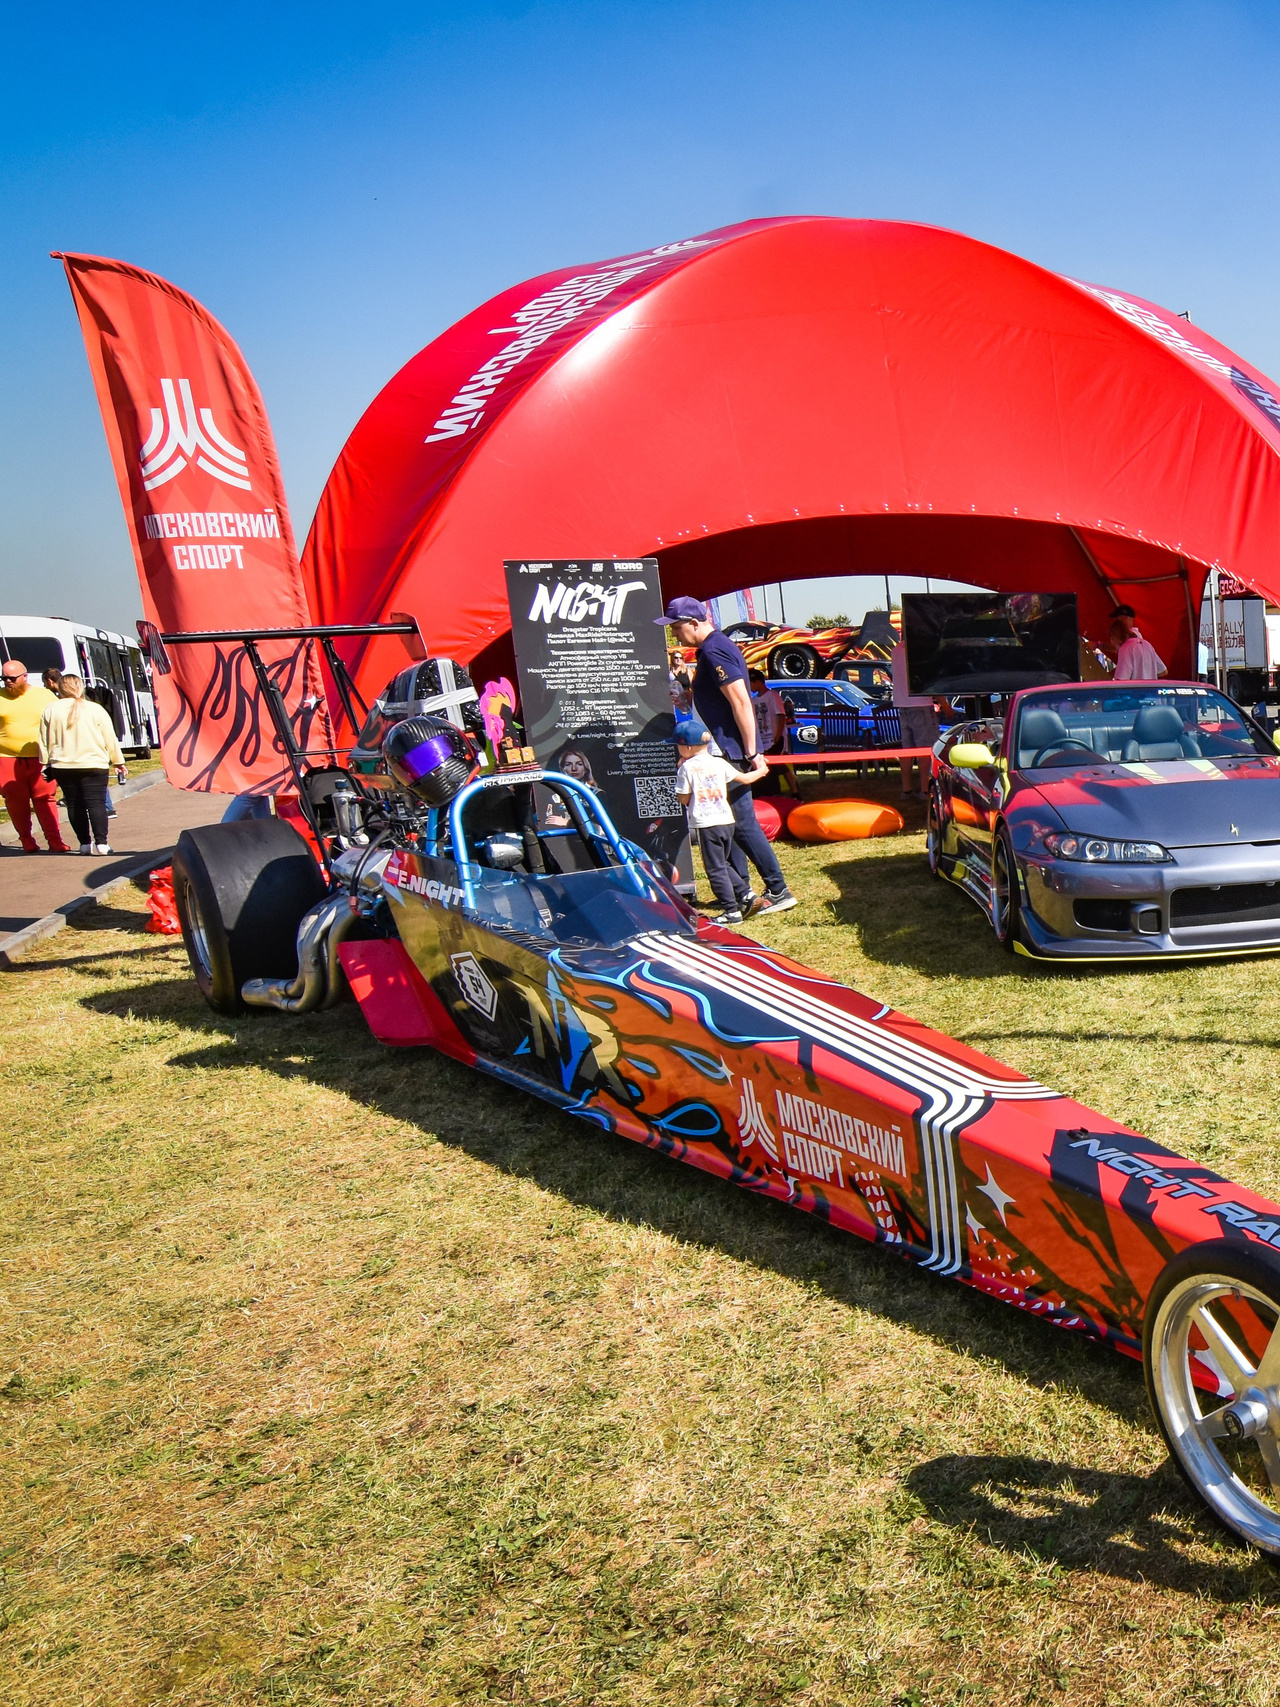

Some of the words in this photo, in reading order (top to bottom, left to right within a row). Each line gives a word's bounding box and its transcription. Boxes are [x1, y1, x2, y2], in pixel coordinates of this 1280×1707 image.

[143, 508, 281, 539] МОСКОВСКИЙ
[172, 544, 244, 570] СПОРТ
[528, 581, 648, 626] NIGHT
[775, 1089, 907, 1178] МОСКОВСКИЙ
[782, 1131, 845, 1188] СПОРТ
[1068, 1137, 1217, 1201] NIGHT
